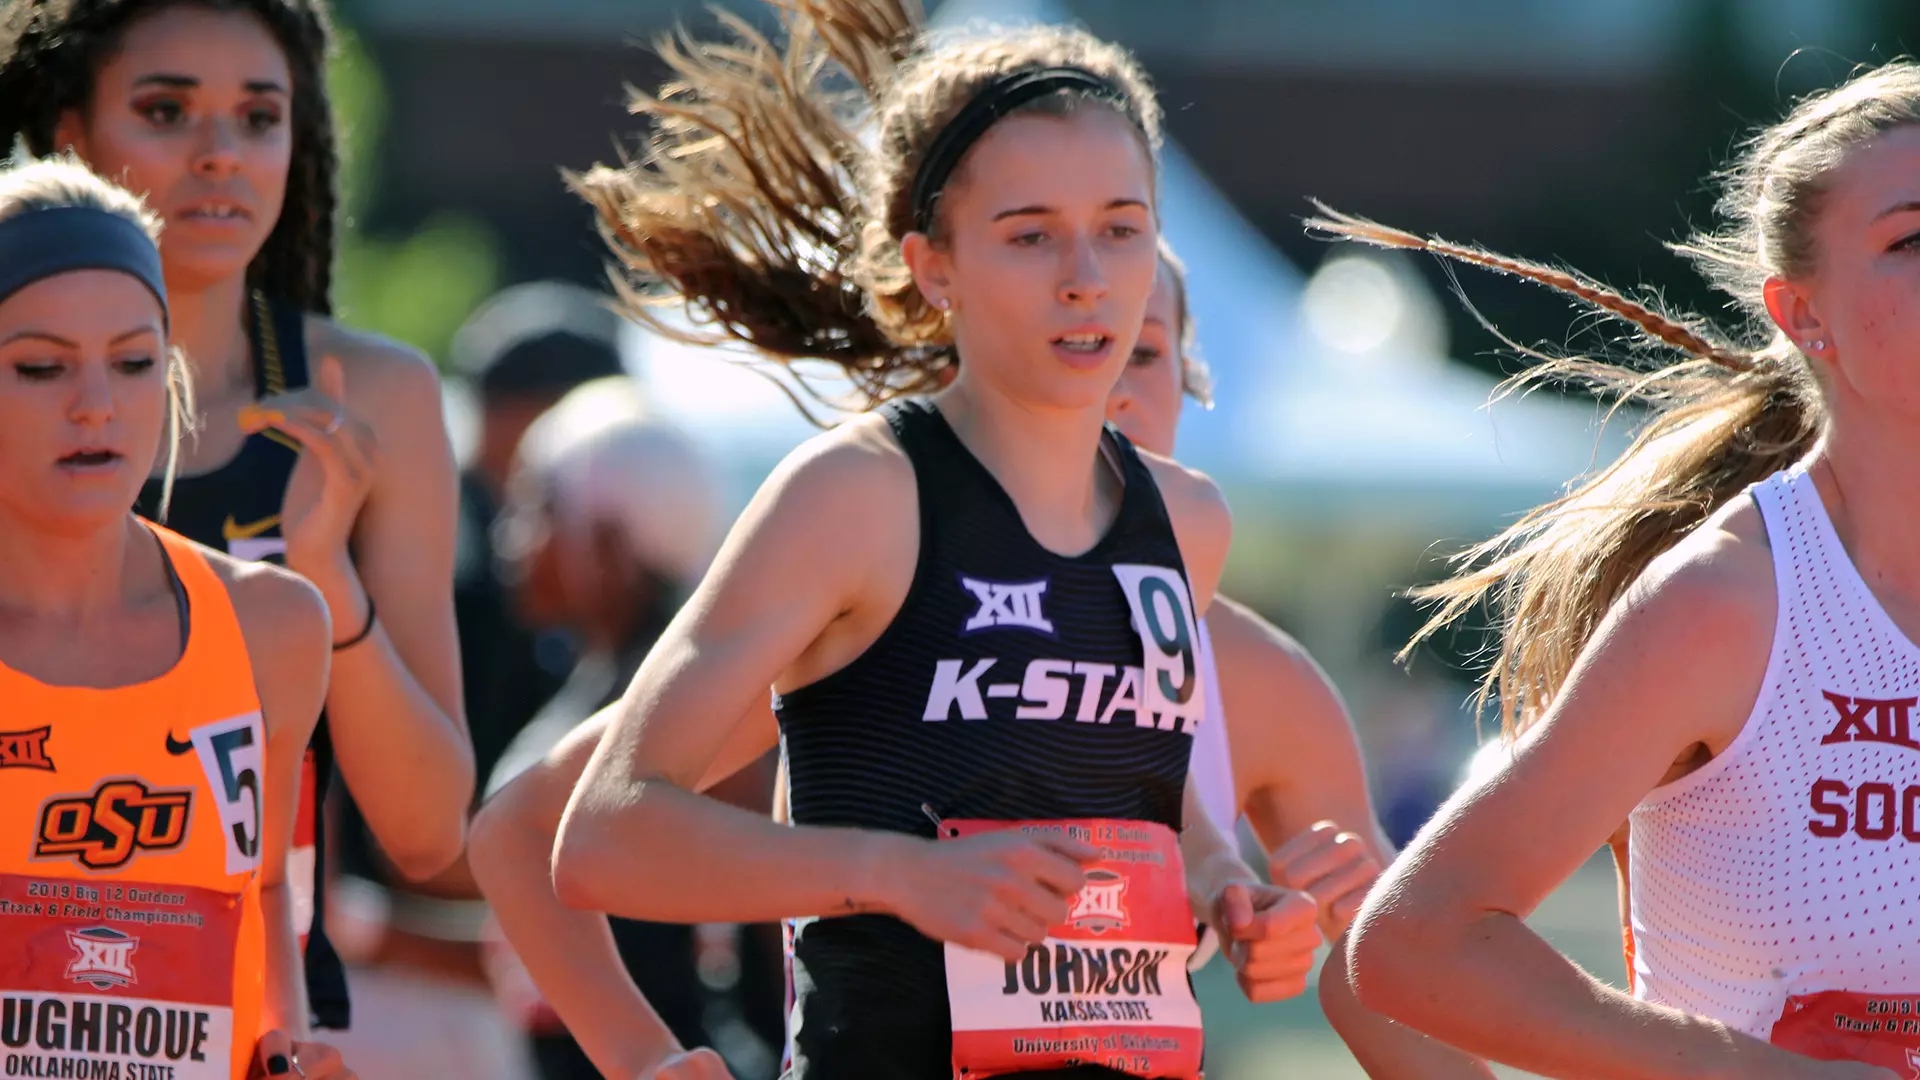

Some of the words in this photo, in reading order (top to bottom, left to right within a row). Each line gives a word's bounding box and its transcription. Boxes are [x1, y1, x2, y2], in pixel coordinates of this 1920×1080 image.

[962, 577, 1053, 633] XII
[1139, 576, 1195, 705] 9
[922, 658, 1198, 733] K-STA
[1820, 689, 1920, 752] XII
[210, 726, 259, 858] 5
[35, 779, 192, 870] OSU
[1068, 825, 1091, 842] Big
[1097, 825, 1113, 840] 12
[28, 883, 70, 898] 2019
[75, 886, 99, 902] Big
[105, 888, 123, 900] 12
[128, 889, 186, 905] Outdoor
[1071, 882, 1125, 920] XII
[0, 901, 42, 914] Track
[63, 904, 101, 918] Field
[105, 907, 204, 926] Championship
[71, 936, 135, 978] XII
[1002, 944, 1170, 996] JOHNSON
[1041, 1000, 1109, 1023] KANSAS
[1107, 1000, 1154, 1021] STATE
[1834, 1013, 1882, 1032] Track
[1866, 999, 1911, 1016] 2019
[1012, 1035, 1099, 1054] University
[1103, 1035, 1117, 1049] of
[5, 1053, 120, 1080] OKLAHOMA
[125, 1062, 175, 1080] STATE
